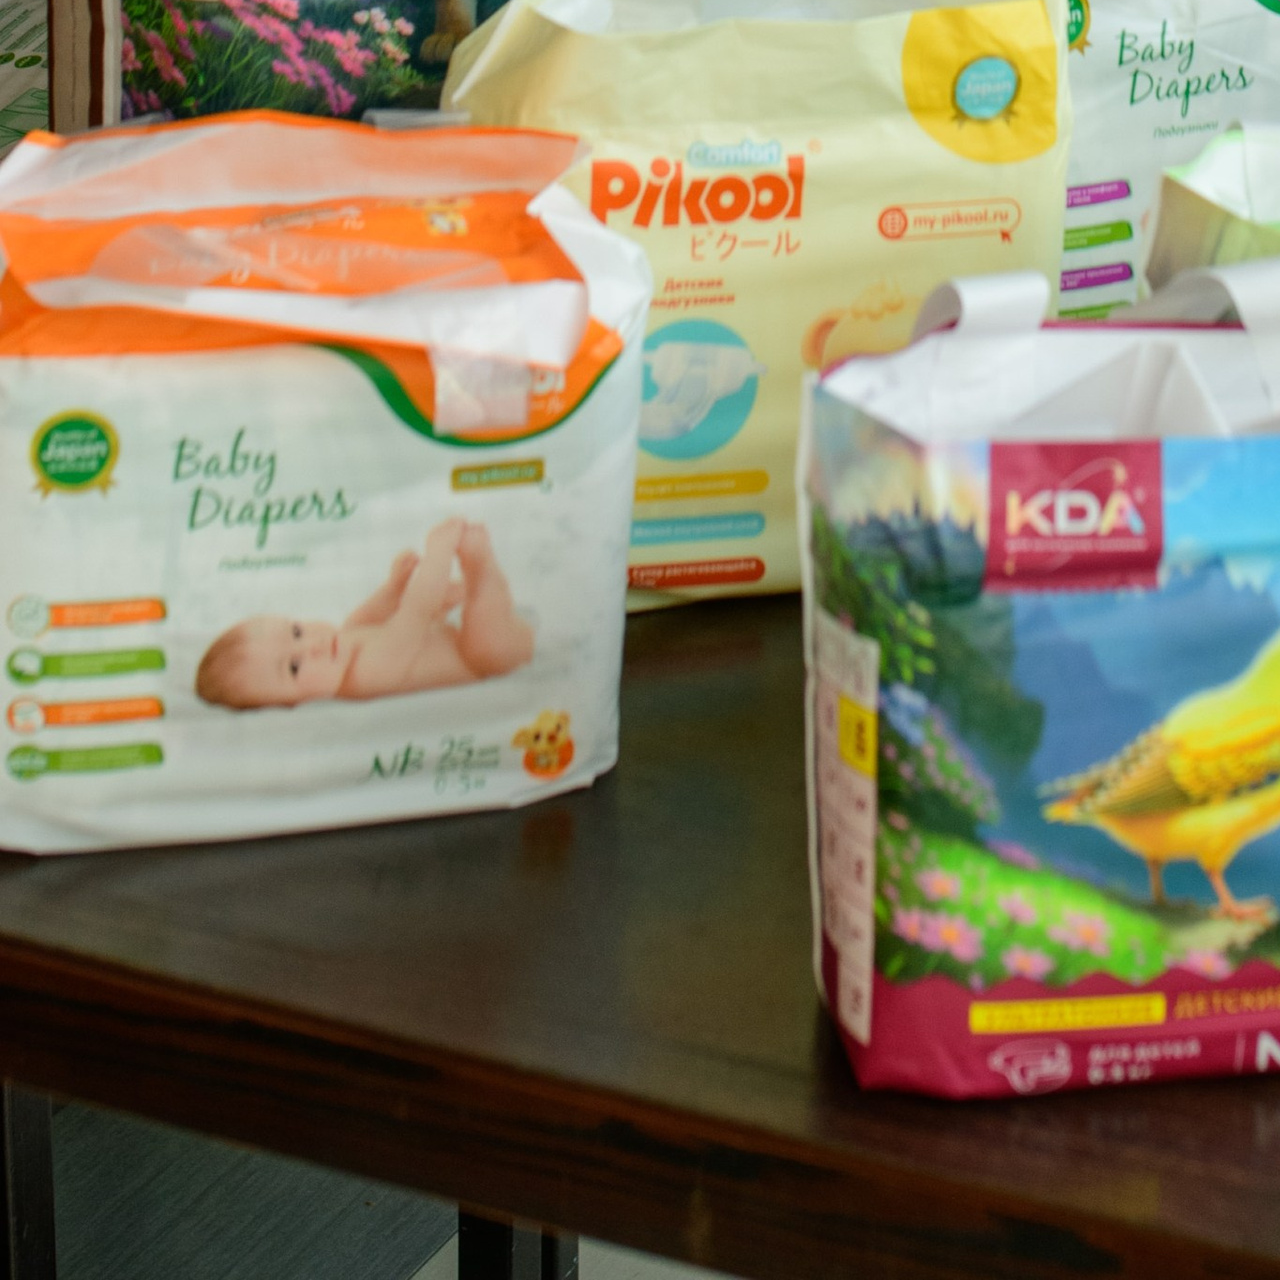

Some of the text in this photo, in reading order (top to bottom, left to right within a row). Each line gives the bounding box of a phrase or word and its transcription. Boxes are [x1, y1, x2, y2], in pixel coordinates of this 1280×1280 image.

[1115, 18, 1195, 75] Baby
[1130, 65, 1255, 119] Diapers
[589, 155, 805, 230] Pikool
[913, 207, 1010, 231] my-pikool.ru
[690, 227, 802, 263] ピクール
[171, 425, 278, 497] Baby
[187, 486, 358, 551] Diapers
[1005, 489, 1145, 537] KDA
